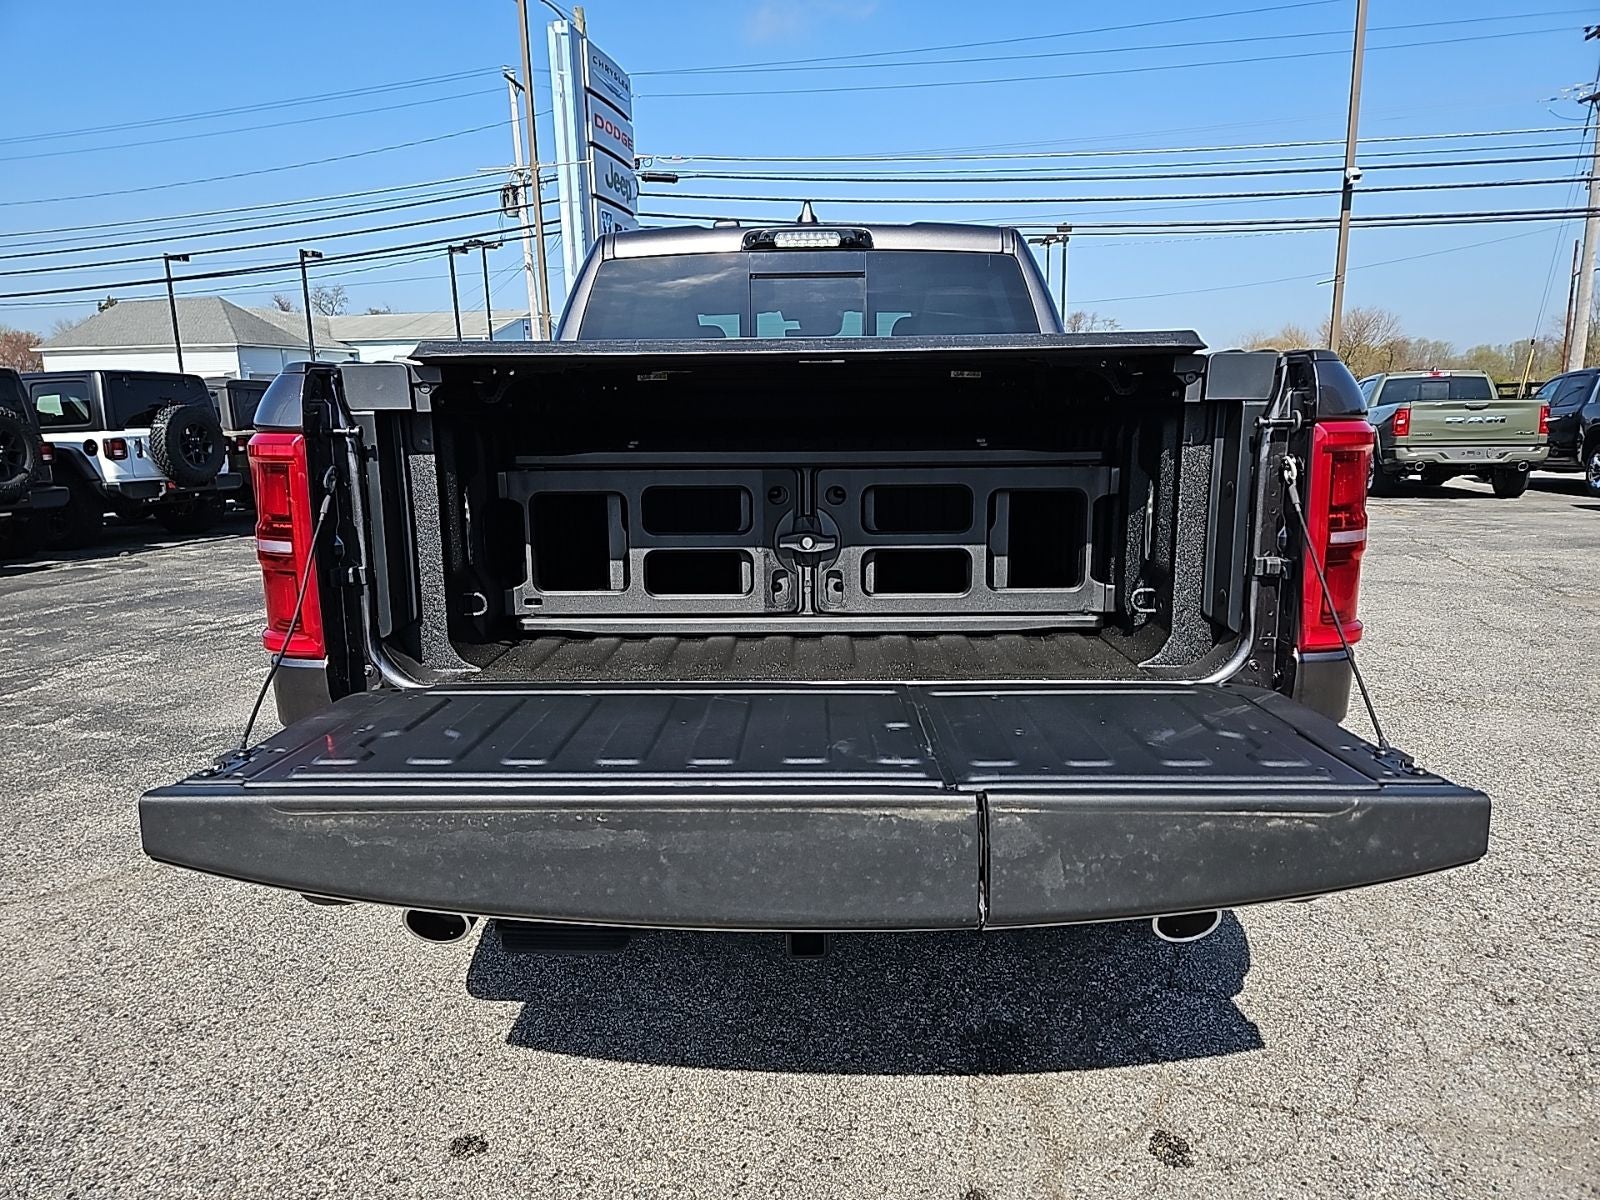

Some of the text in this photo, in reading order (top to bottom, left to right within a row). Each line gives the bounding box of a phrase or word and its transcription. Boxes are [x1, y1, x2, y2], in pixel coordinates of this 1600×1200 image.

[592, 55, 629, 93] CHRYSLER
[594, 112, 633, 152] DODGE
[605, 161, 632, 204] Jeep
[1445, 416, 1507, 424] RAM
